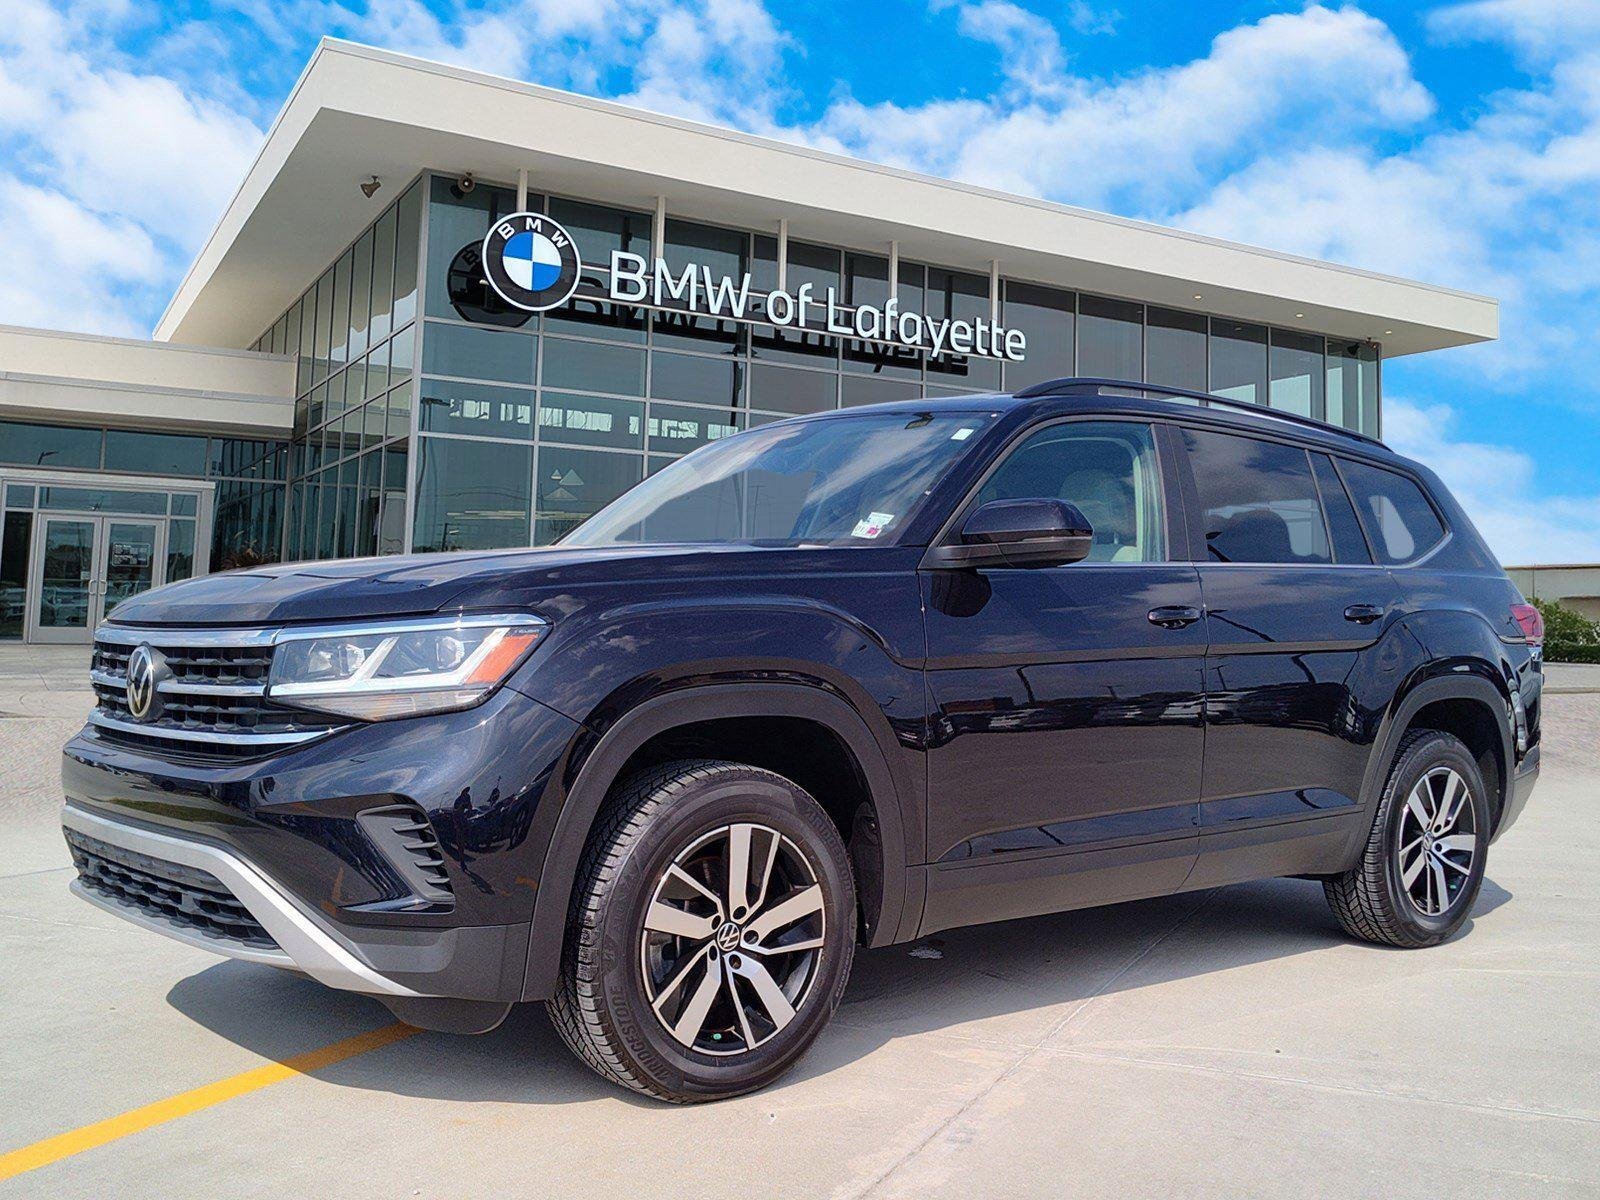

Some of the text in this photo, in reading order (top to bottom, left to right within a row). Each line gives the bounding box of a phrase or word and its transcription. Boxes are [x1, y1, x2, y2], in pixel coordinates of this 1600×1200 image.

[497, 217, 569, 248] BMW
[610, 249, 1026, 361] BMW of Lafayette
